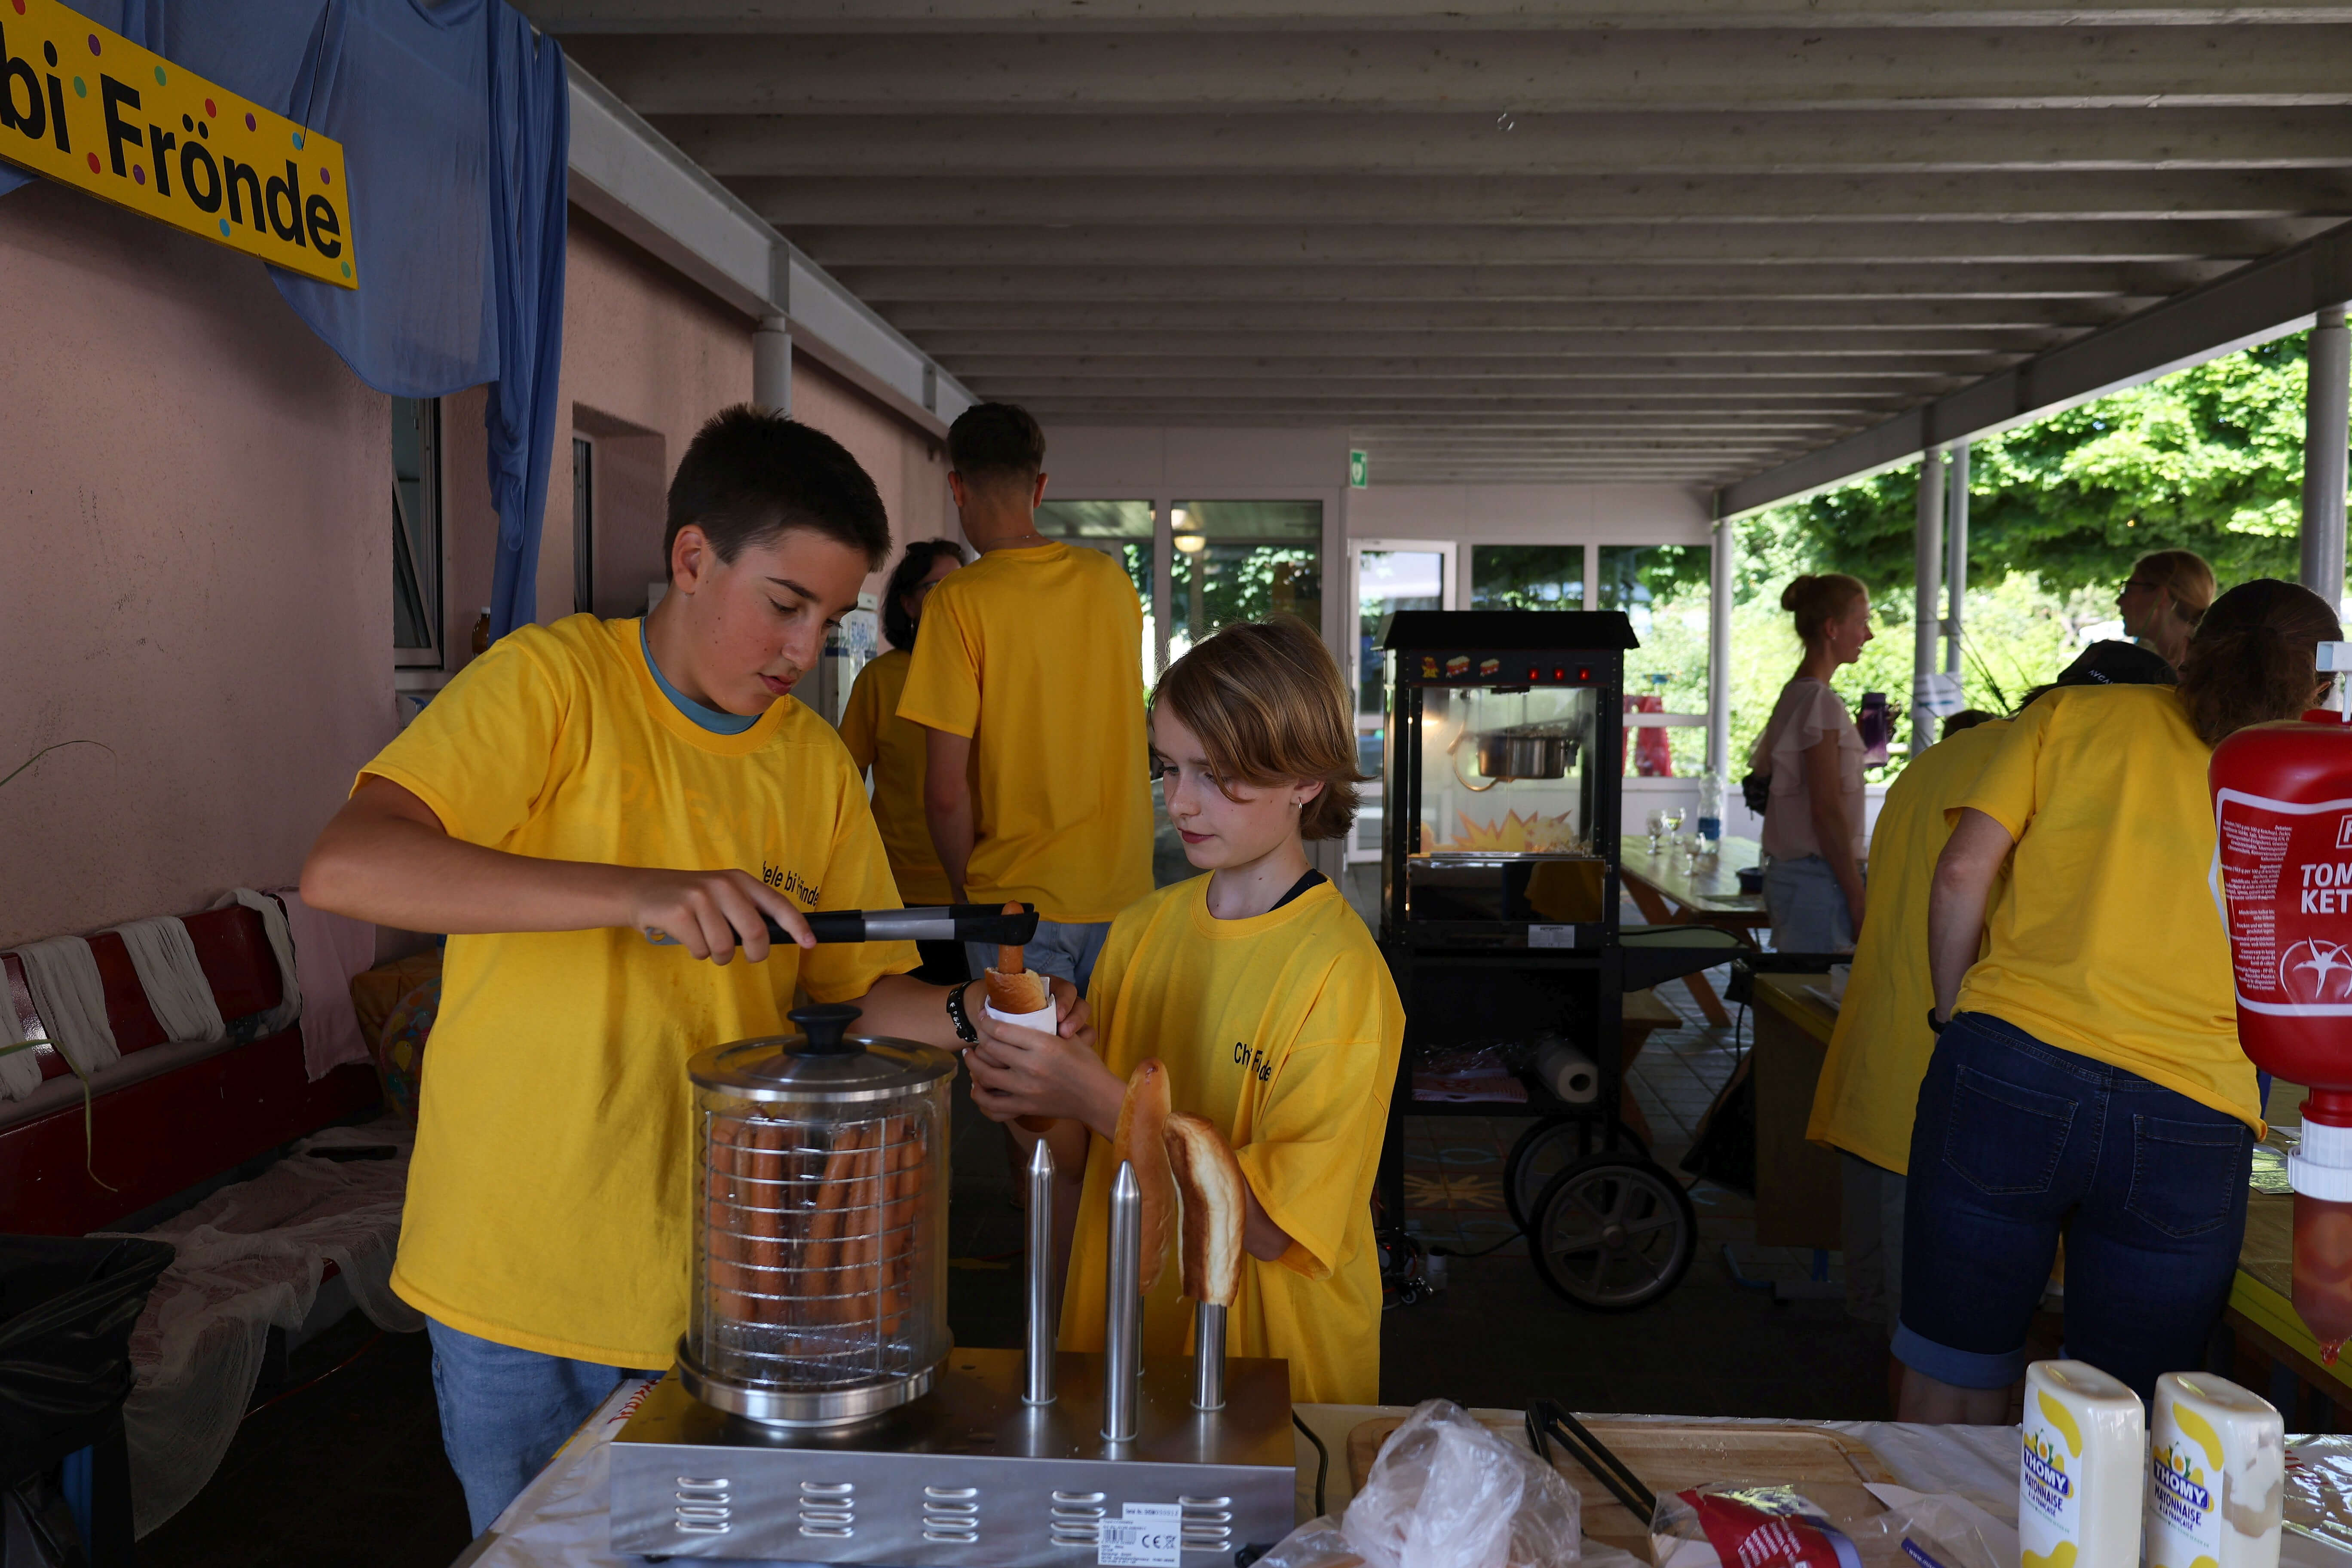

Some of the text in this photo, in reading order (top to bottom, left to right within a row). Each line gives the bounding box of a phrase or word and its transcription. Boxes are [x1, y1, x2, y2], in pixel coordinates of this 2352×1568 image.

[0, 21, 342, 259] bi Frönde
[2301, 888, 2352, 914] KET
[2024, 1447, 2066, 1491] THOMY
[2155, 1461, 2206, 1506] THOMY
[2024, 1470, 2063, 1513] MAYONNAISE
[2154, 1483, 2202, 1527] MAYONNAISE
